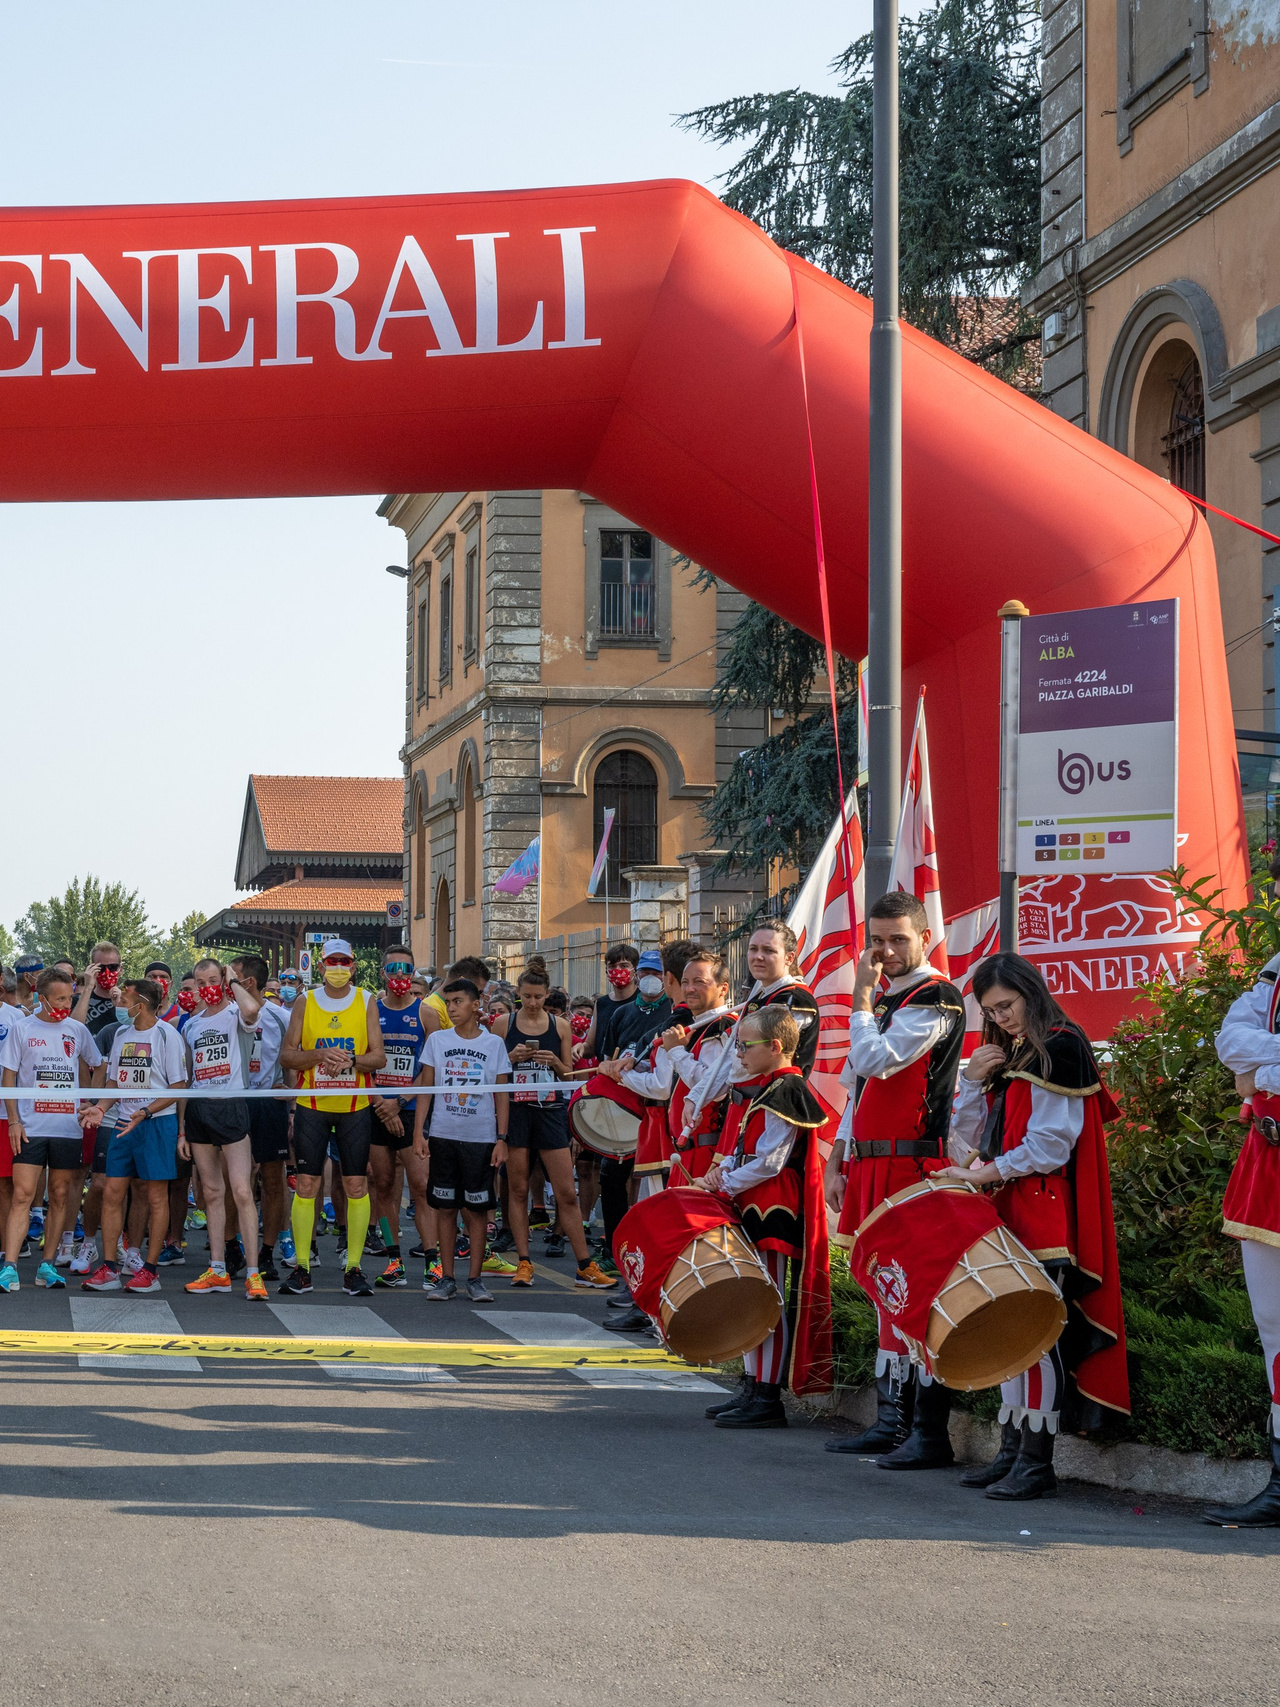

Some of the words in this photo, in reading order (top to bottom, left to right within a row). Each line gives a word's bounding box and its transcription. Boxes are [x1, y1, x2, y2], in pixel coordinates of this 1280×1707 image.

[1039, 633, 1060, 644] Città
[1061, 632, 1069, 641] di
[1039, 646, 1075, 661] ALBA
[1039, 677, 1072, 687] Fermata
[1074, 669, 1107, 683] 4224
[1038, 690, 1074, 702] PIAZZA
[1076, 684, 1133, 699] GARIBALDI
[1035, 819, 1055, 827] LINEA
[1043, 851, 1048, 859] 5
[1066, 850, 1072, 858] 6
[1029, 908, 1044, 916] VAN
[28, 1039, 47, 1047] IDEA
[205, 1035, 225, 1045] IDEA
[315, 1037, 355, 1050] AVIS
[195, 1051, 204, 1064] 13
[206, 1046, 228, 1062] 259
[393, 1046, 411, 1055] IDEA
[444, 1048, 466, 1058] URBAN
[467, 1048, 487, 1062] SKATE
[32, 1063, 49, 1071] Santa
[131, 1058, 148, 1066] IDEA
[393, 1057, 411, 1071] 157
[53, 1072, 71, 1081] IDEA
[119, 1069, 128, 1082] 13
[133, 1069, 145, 1083] 30
[516, 1073, 527, 1083] 13
[446, 1104, 460, 1113] READY
[467, 1107, 477, 1115] RIDE
[72, 1340, 370, 1359] Triangolo
